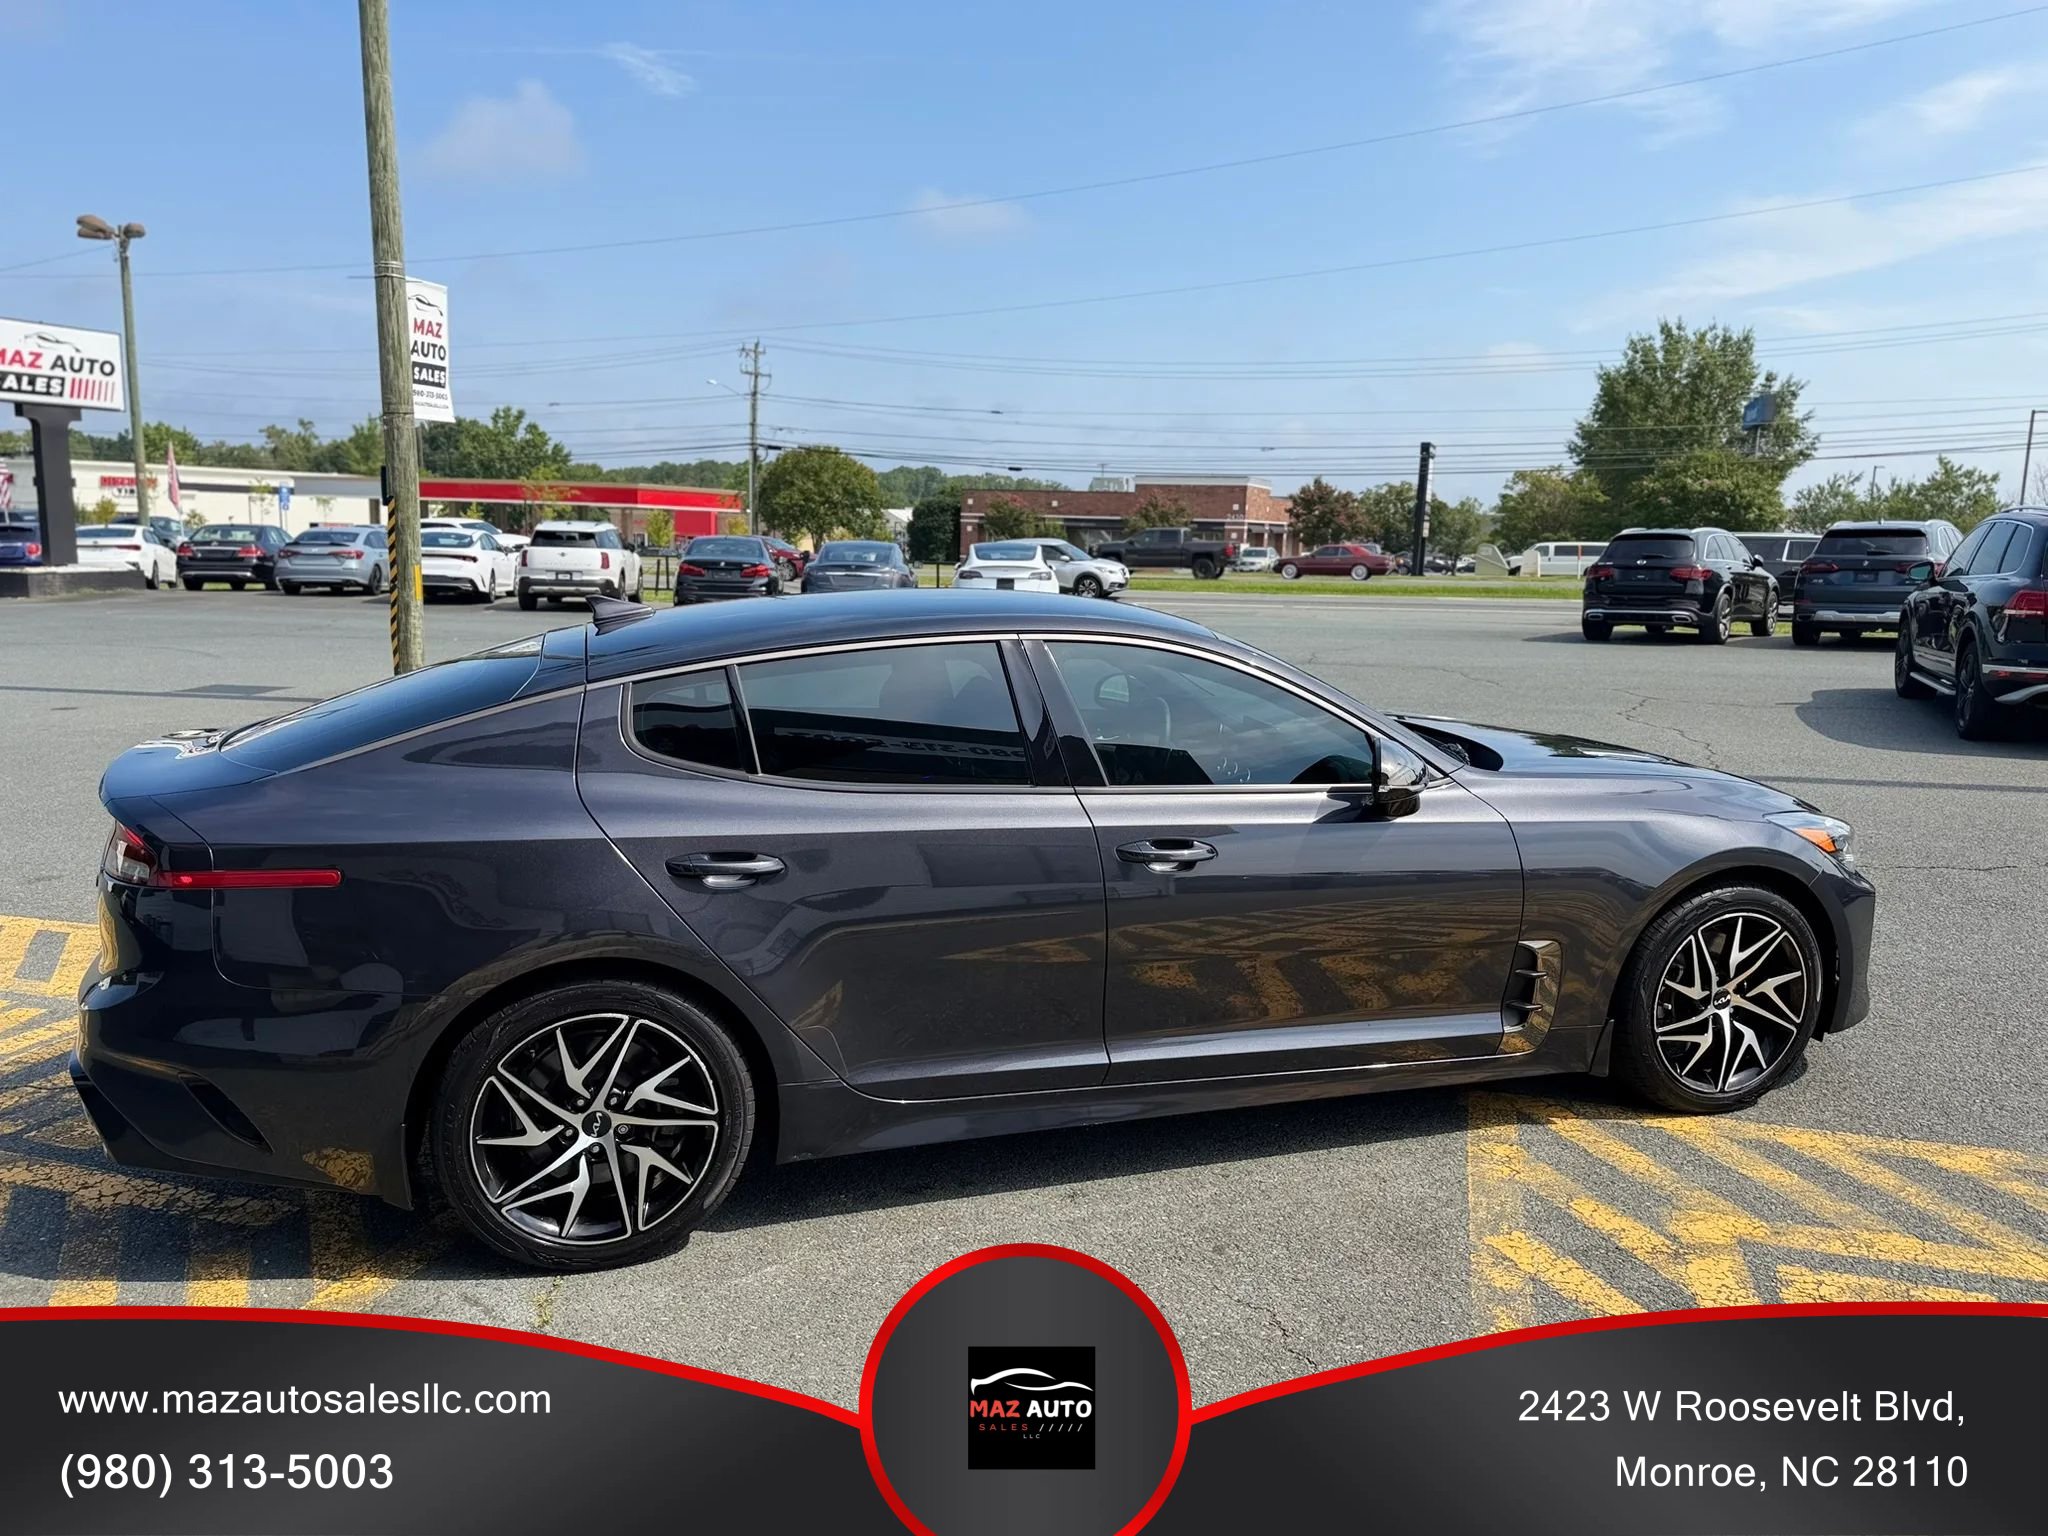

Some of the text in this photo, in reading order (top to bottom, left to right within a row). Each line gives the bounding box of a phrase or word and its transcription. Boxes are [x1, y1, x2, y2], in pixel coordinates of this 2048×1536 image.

[413, 318, 442, 339] MAZ
[411, 340, 446, 361] AUTO
[50, 354, 116, 377] AUTO
[414, 367, 445, 384] SALES
[0, 373, 63, 395] ALES
